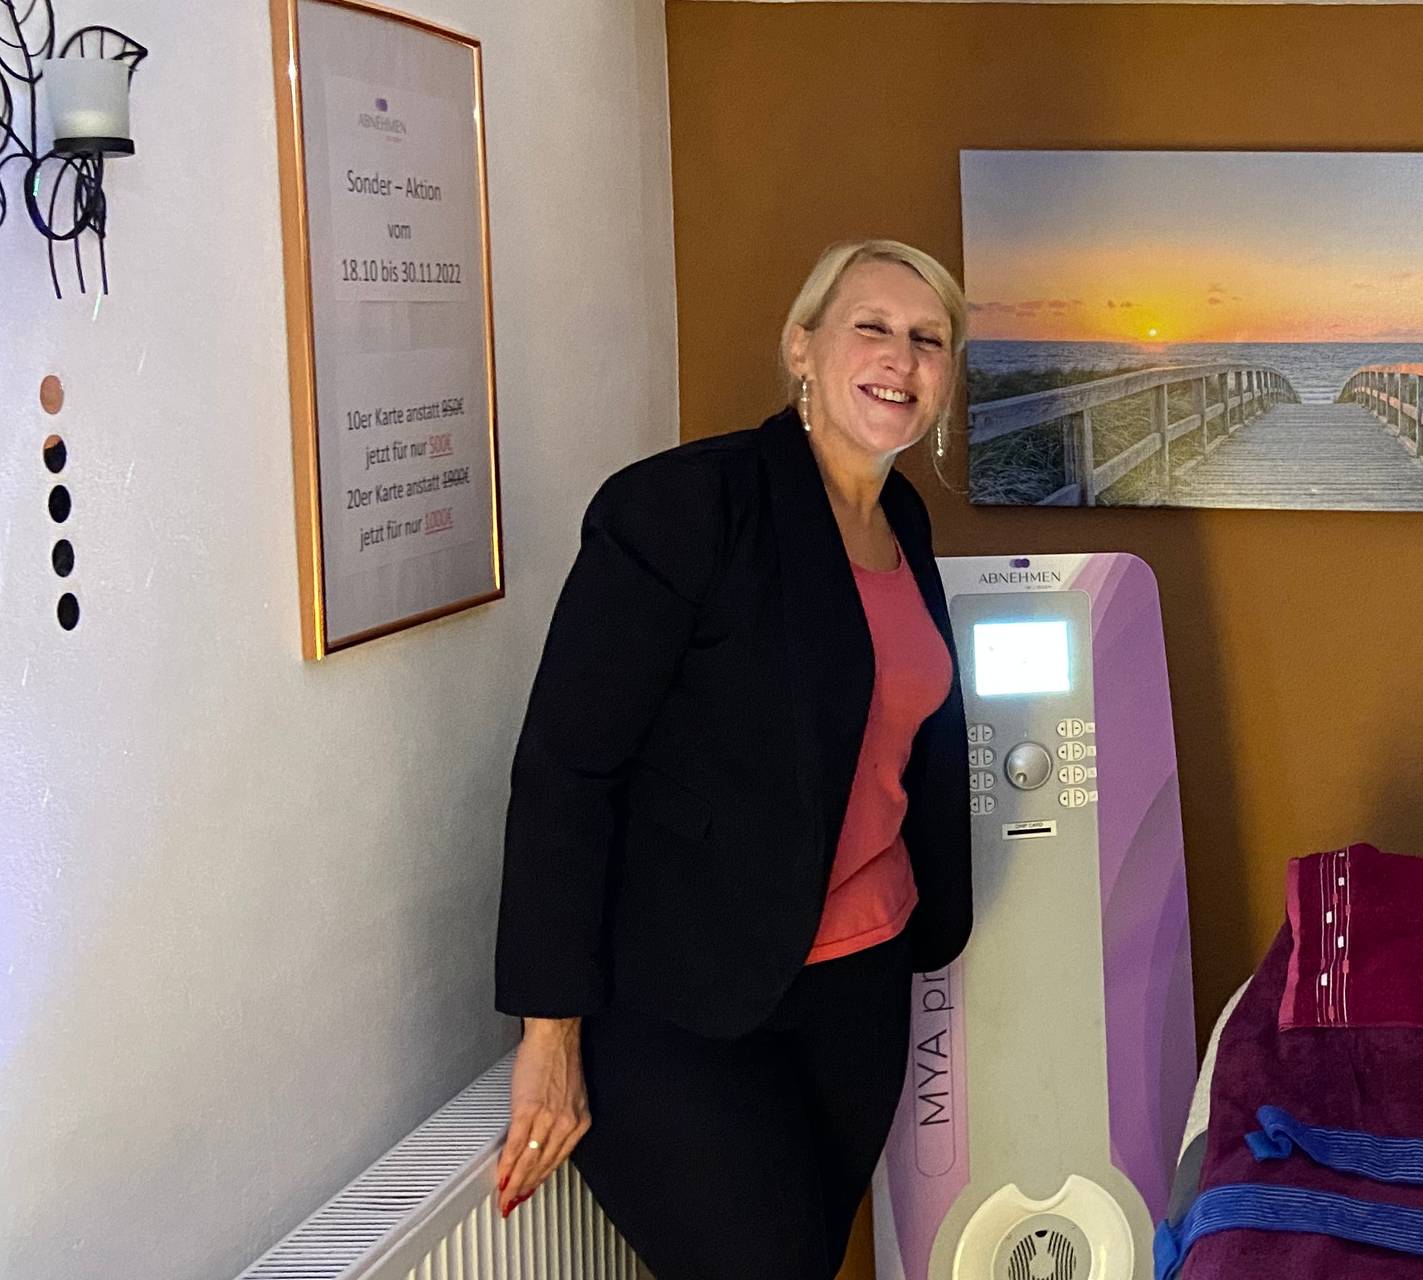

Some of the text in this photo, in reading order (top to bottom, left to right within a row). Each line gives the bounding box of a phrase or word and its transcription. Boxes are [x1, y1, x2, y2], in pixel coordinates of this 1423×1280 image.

[347, 169, 392, 196] Sonder
[405, 177, 442, 201] Aktion
[387, 223, 412, 240] vom
[342, 259, 462, 284] 18.10 bis 30.11.2022
[347, 410, 372, 431] 10er
[375, 407, 404, 427] Karte
[406, 403, 441, 424] anstatt
[365, 446, 391, 470] jetzt
[392, 440, 408, 461] für
[410, 440, 427, 457] nur
[346, 489, 373, 510] 20er
[375, 483, 404, 503] Karte
[406, 475, 441, 497] anstatt
[359, 527, 385, 552] jetzt
[386, 519, 402, 541] für
[404, 516, 423, 532] nur
[978, 571, 1061, 585] ABNEHMEN
[917, 1029, 950, 1126] MYA
